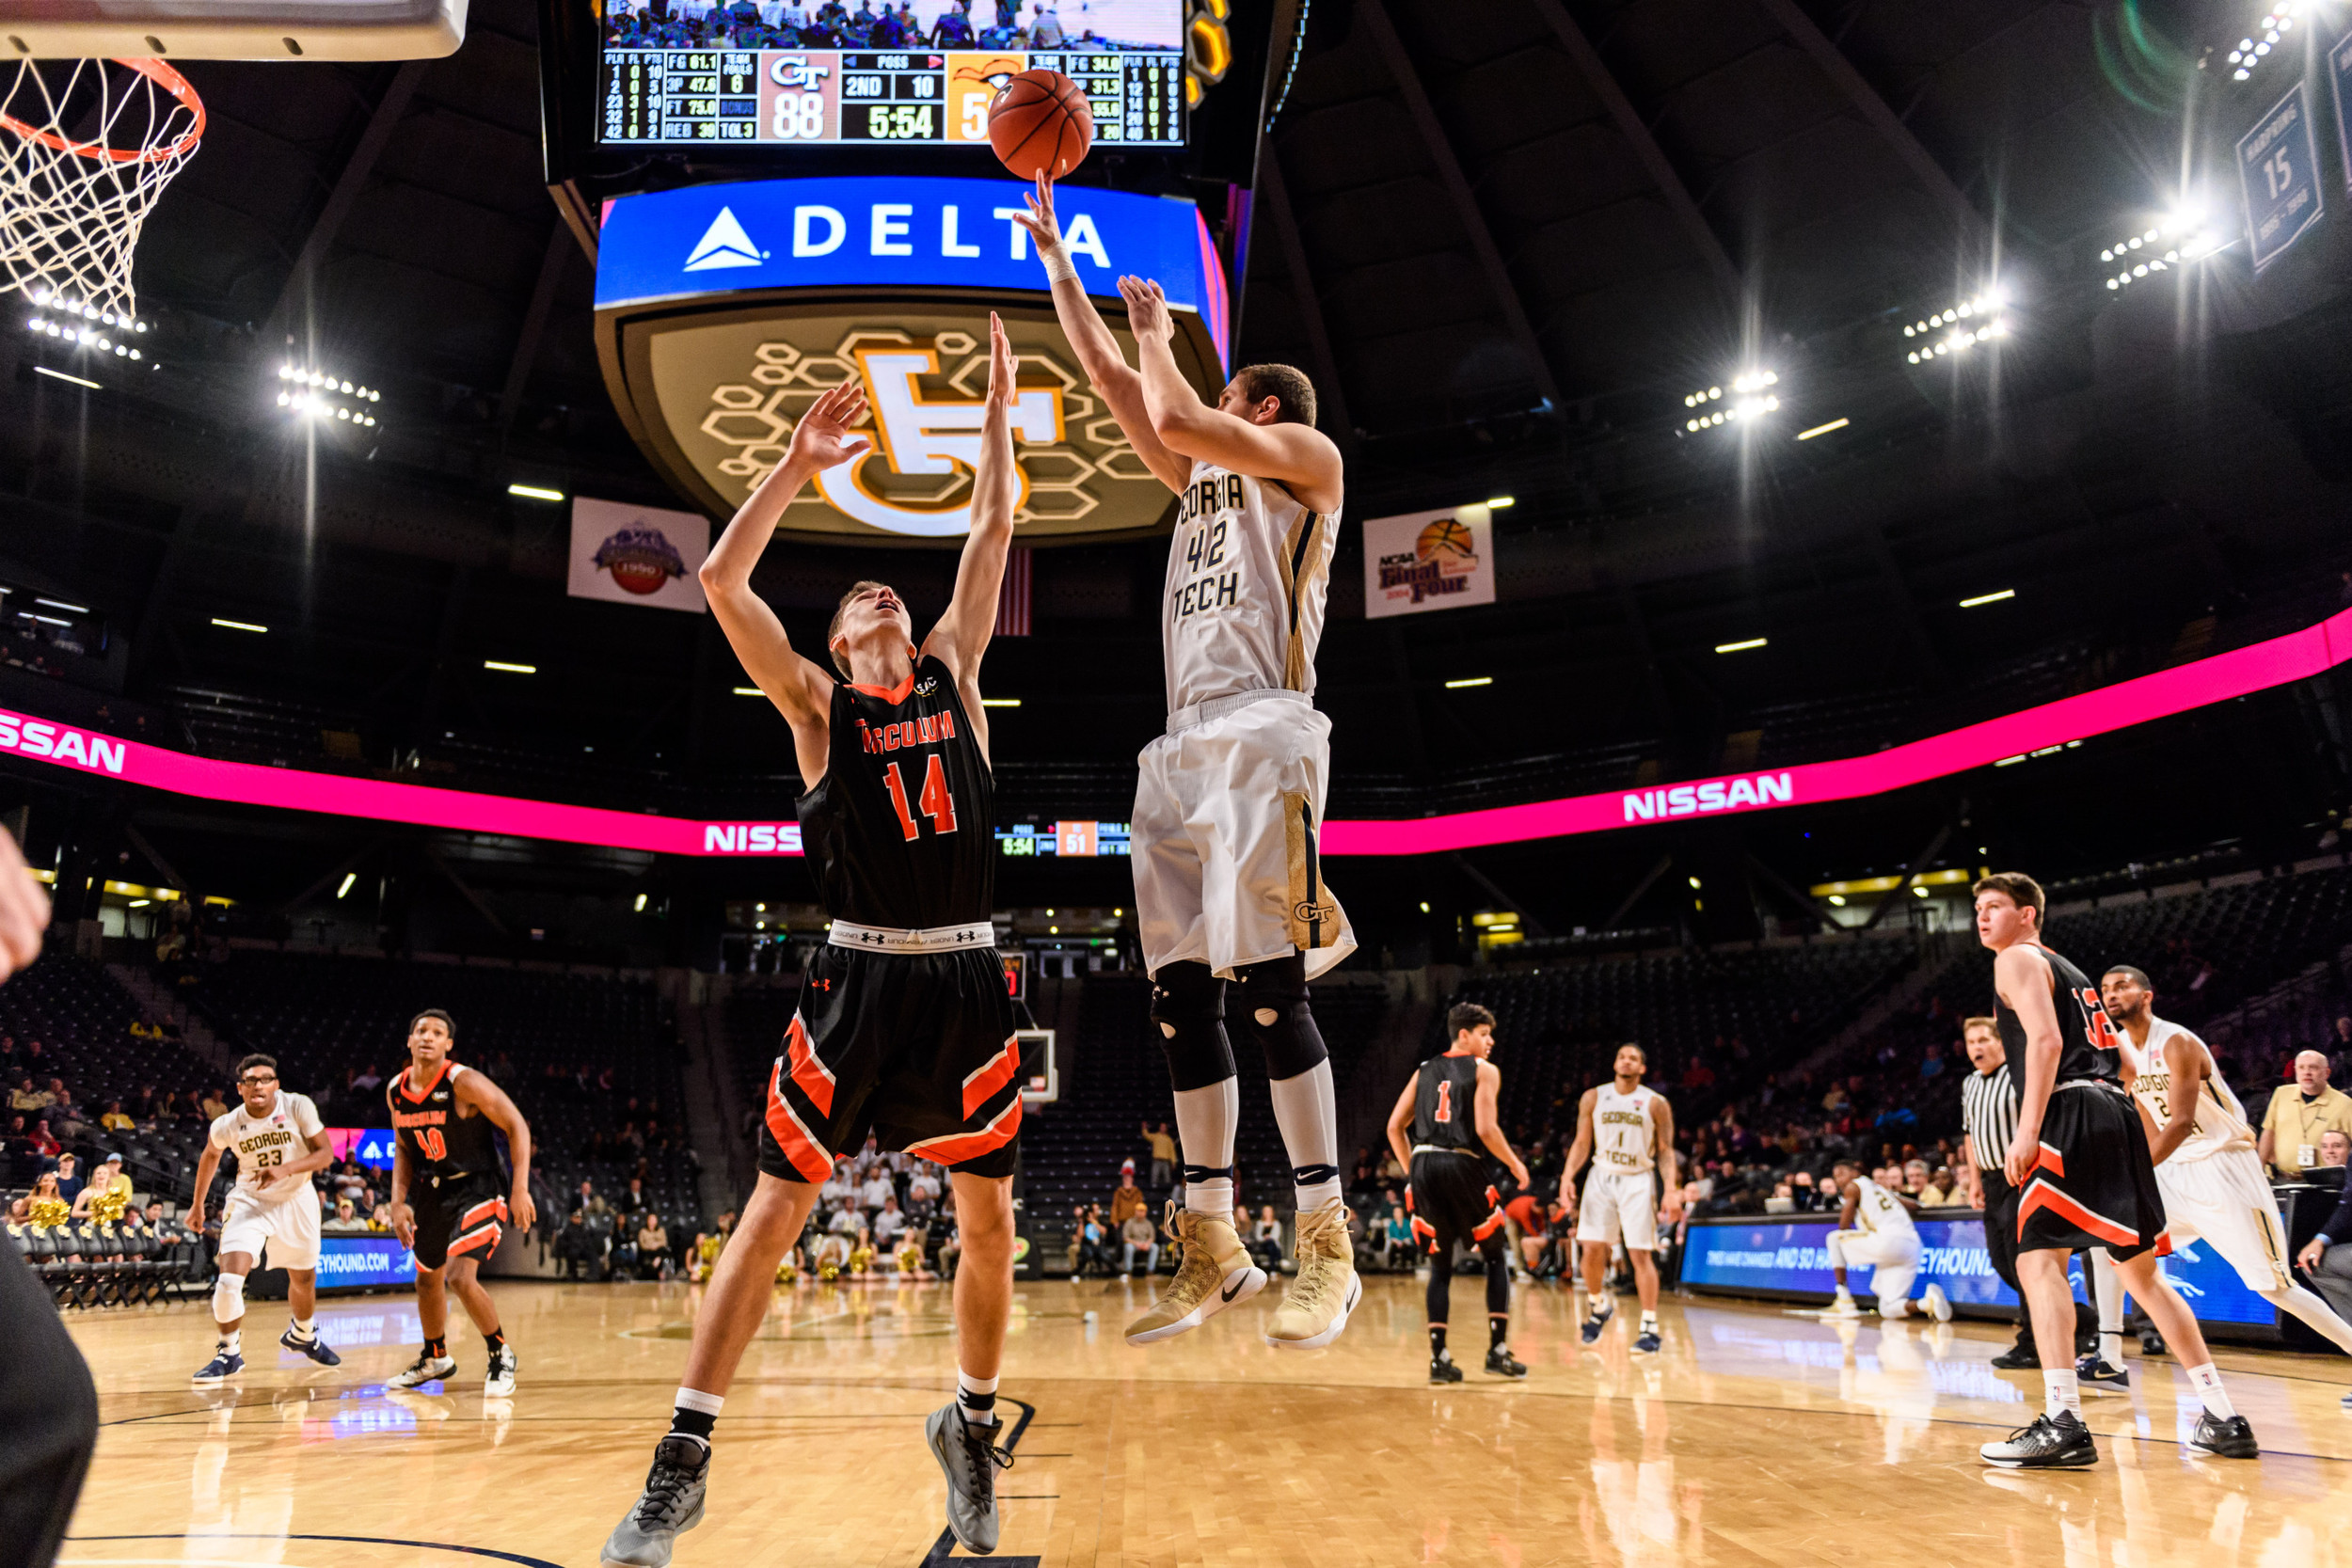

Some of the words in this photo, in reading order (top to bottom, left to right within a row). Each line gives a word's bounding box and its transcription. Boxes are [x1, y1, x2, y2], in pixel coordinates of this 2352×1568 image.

[612, 65, 620, 80] 1
[629, 65, 640, 80] 0
[647, 65, 662, 80] 10
[668, 55, 687, 70] FG
[689, 54, 717, 70] 61.1
[770, 55, 830, 91] GT
[877, 55, 909, 70] POSS
[1071, 56, 1089, 71] FG
[846, 75, 882, 97] 2ND
[912, 76, 934, 98] 10
[1131, 68, 1138, 82] 1
[611, 80, 620, 94] 2
[629, 80, 640, 94] 0
[648, 80, 659, 94] 5
[1127, 82, 1143, 97] 12
[1150, 82, 1158, 97] 1
[606, 95, 624, 109] 23
[628, 95, 639, 109] 3
[646, 94, 662, 109] 10
[666, 100, 682, 115] FT
[688, 100, 716, 115] 75.0
[605, 109, 623, 124] 32
[630, 109, 638, 124] 1
[772, 92, 824, 139] 88
[868, 105, 933, 139] 5:54
[961, 92, 990, 140] 5
[605, 124, 623, 139] 42
[628, 124, 638, 138] 0
[647, 124, 658, 138] 2
[1150, 126, 1158, 141] 1
[2263, 145, 2293, 199] 15
[792, 204, 1112, 268] DELTA
[1181, 473, 1246, 525] EORGIA
[1187, 519, 1228, 575] 42
[1379, 560, 1439, 590] Final
[1174, 572, 1239, 623] TECH
[1410, 576, 1468, 604] Four
[0, 714, 125, 774] SSAN
[882, 753, 958, 842] 14
[1623, 772, 1793, 821] NISSAN
[705, 825, 803, 851] NISS
[1003, 837, 1034, 855] 5:54
[1066, 833, 1086, 854] 51
[1294, 901, 1334, 924] GT
[1435, 1080, 1452, 1123] 1
[2153, 1097, 2172, 1118] 2
[1601, 1111, 1645, 1127] GEORGIA
[239, 1131, 292, 1154] GEORGIA
[1618, 1132, 1624, 1148] 1
[257, 1149, 282, 1167] 23
[1605, 1150, 1637, 1166] TECH
[315, 1253, 389, 1274] EYHOUND.COM
[1813, 1247, 1835, 1271] HA
[1917, 1248, 1996, 1275] EYHOUN
